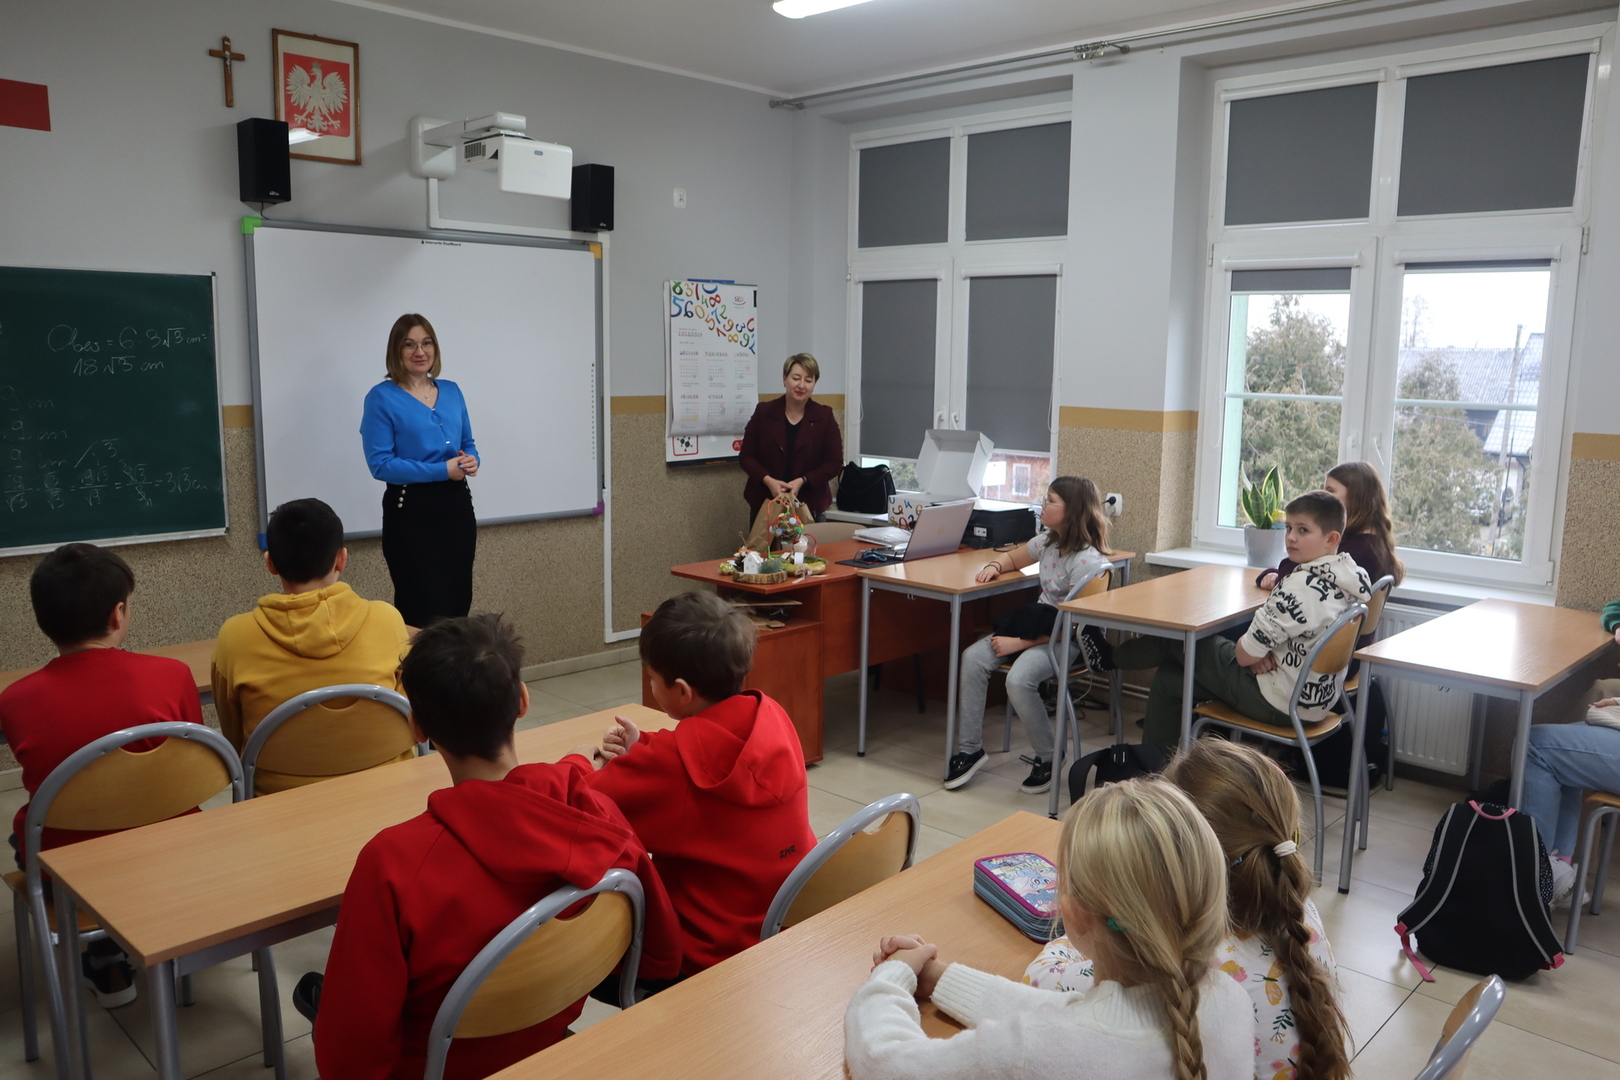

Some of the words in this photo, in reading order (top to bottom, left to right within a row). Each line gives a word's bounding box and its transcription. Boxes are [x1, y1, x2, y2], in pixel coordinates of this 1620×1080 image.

[671, 295, 684, 317] 5
[684, 300, 694, 318] 6
[695, 305, 705, 319] 0
[709, 294, 721, 307] 8
[118, 326, 138, 349] 6
